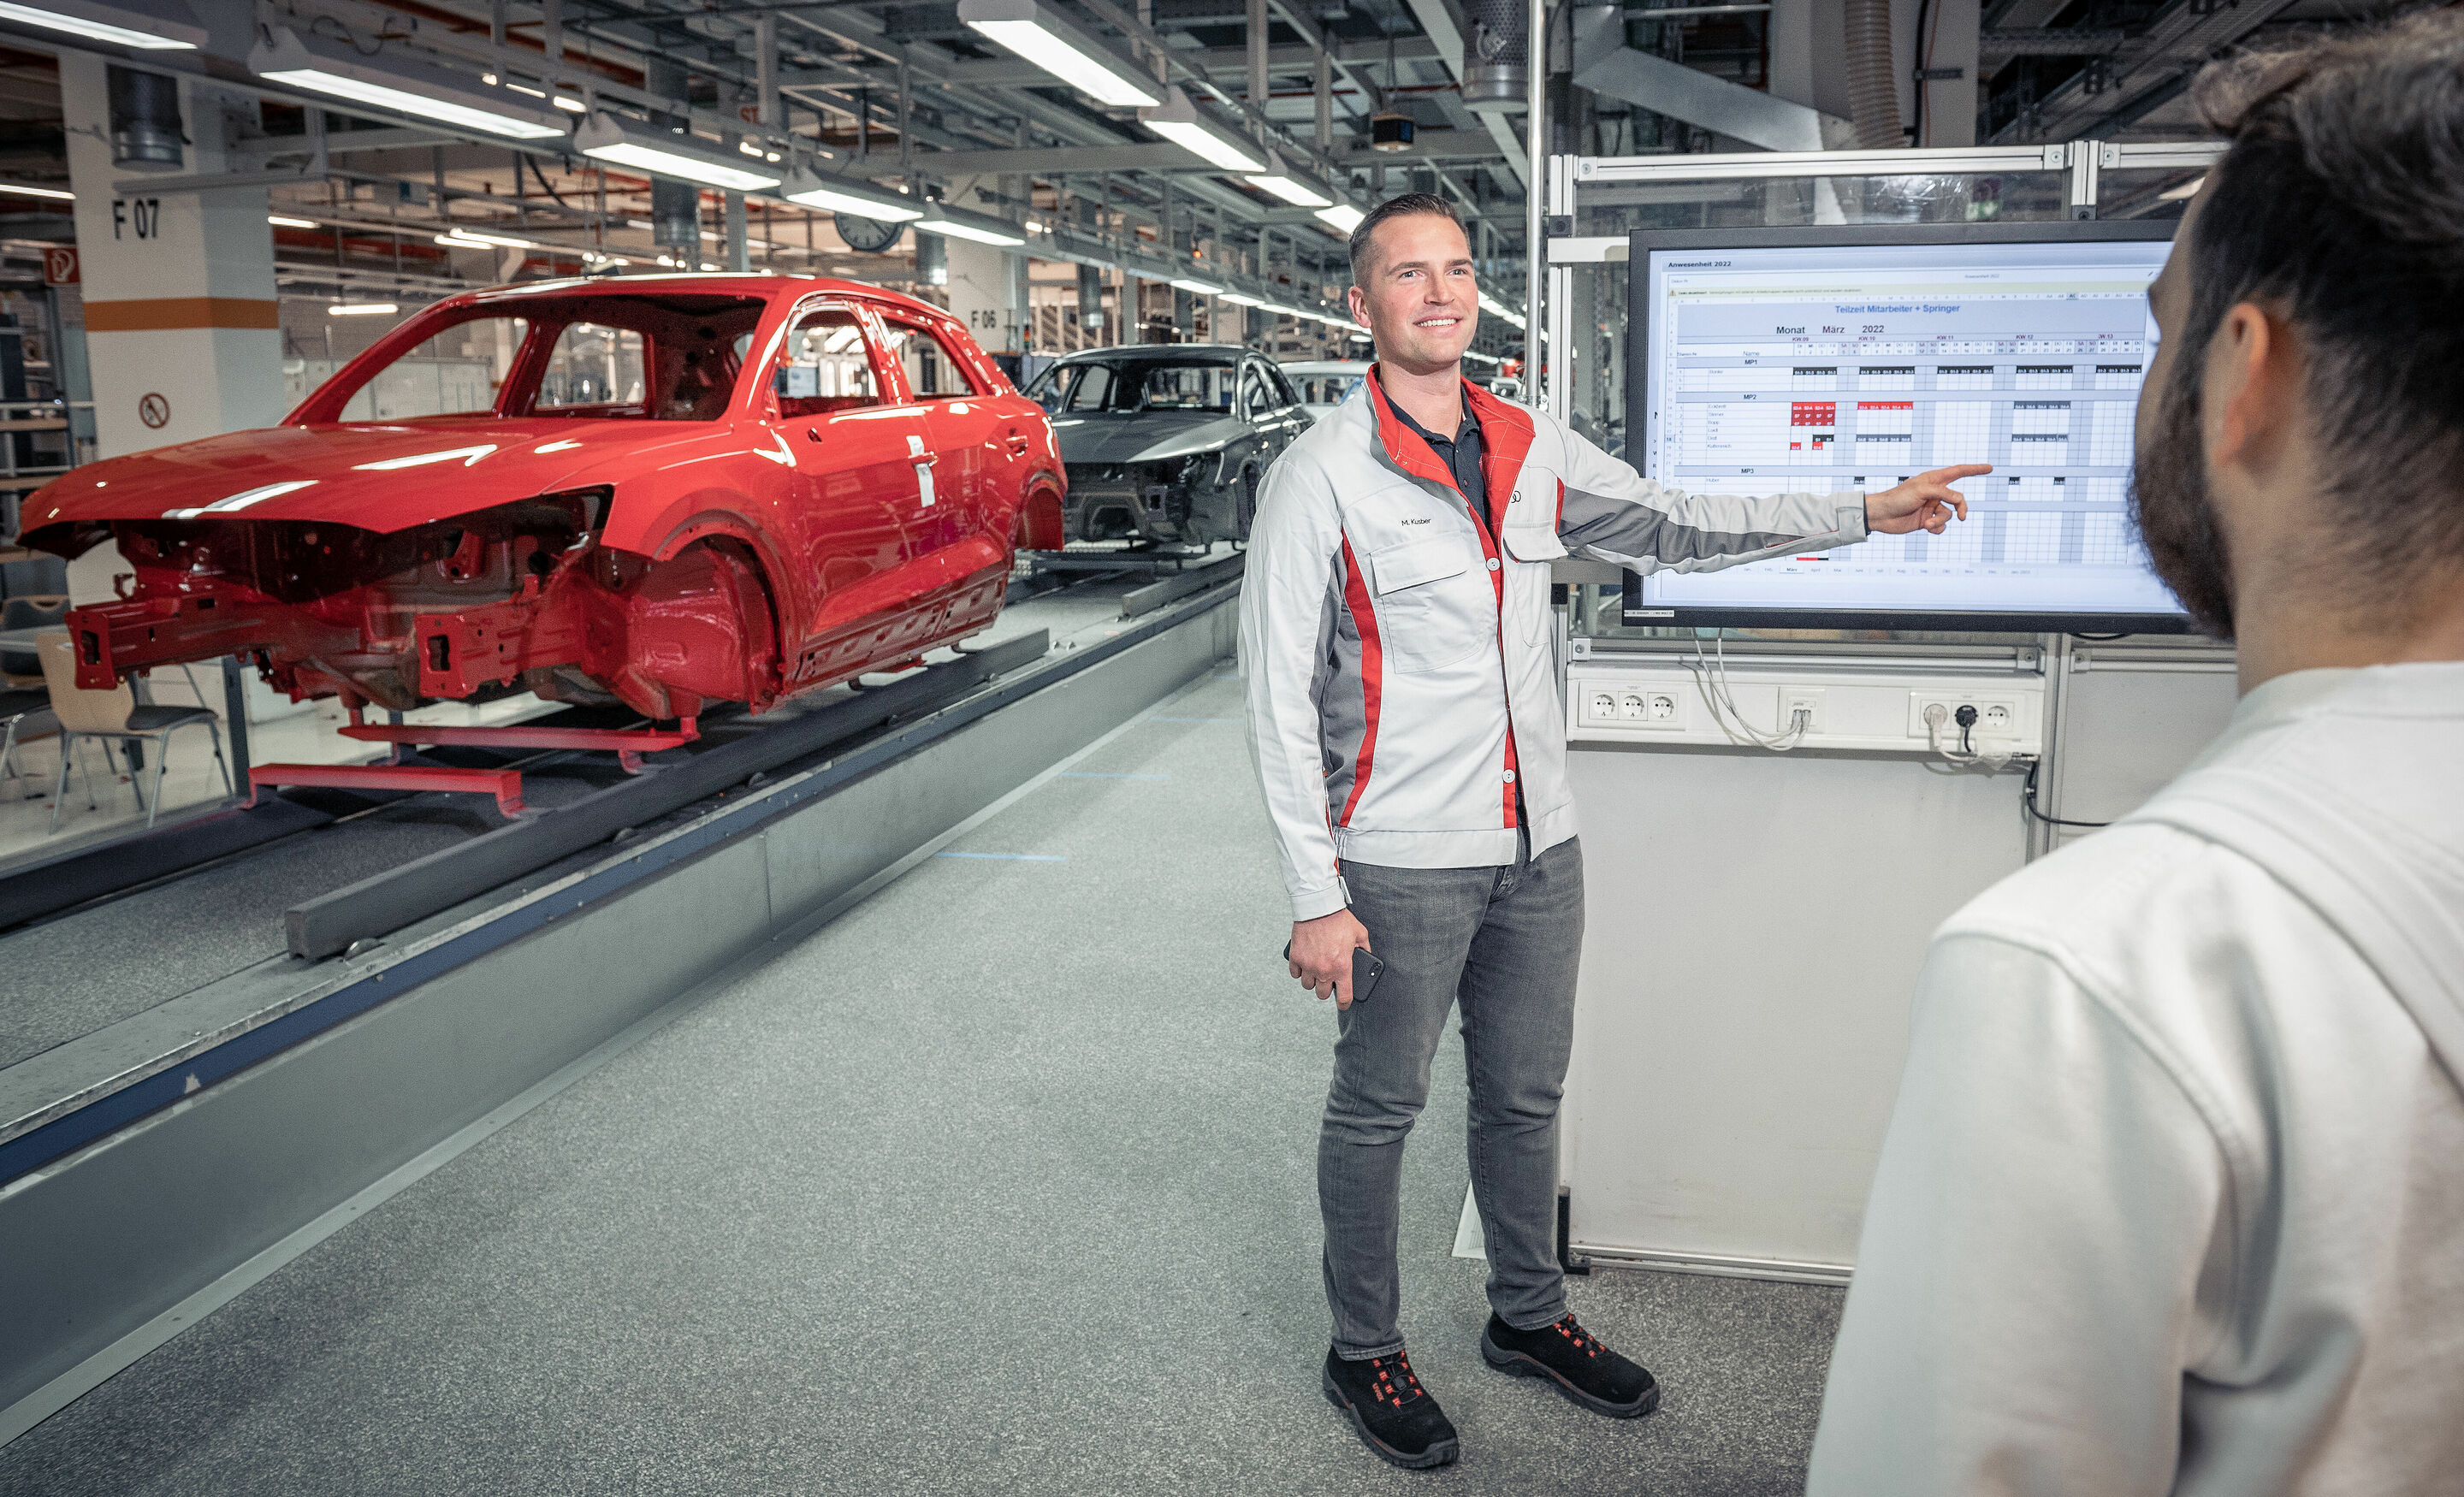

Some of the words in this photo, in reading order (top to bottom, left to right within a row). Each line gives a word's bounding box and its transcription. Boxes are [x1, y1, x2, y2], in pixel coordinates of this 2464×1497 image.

[112, 199, 126, 239] F
[134, 198, 158, 239] 07
[1867, 305, 1912, 313] Mitarbeiter
[1923, 304, 1960, 313] Springer
[971, 310, 978, 328] F
[982, 310, 997, 328] 06
[1776, 326, 1805, 334] Monat
[1823, 325, 1845, 334] März
